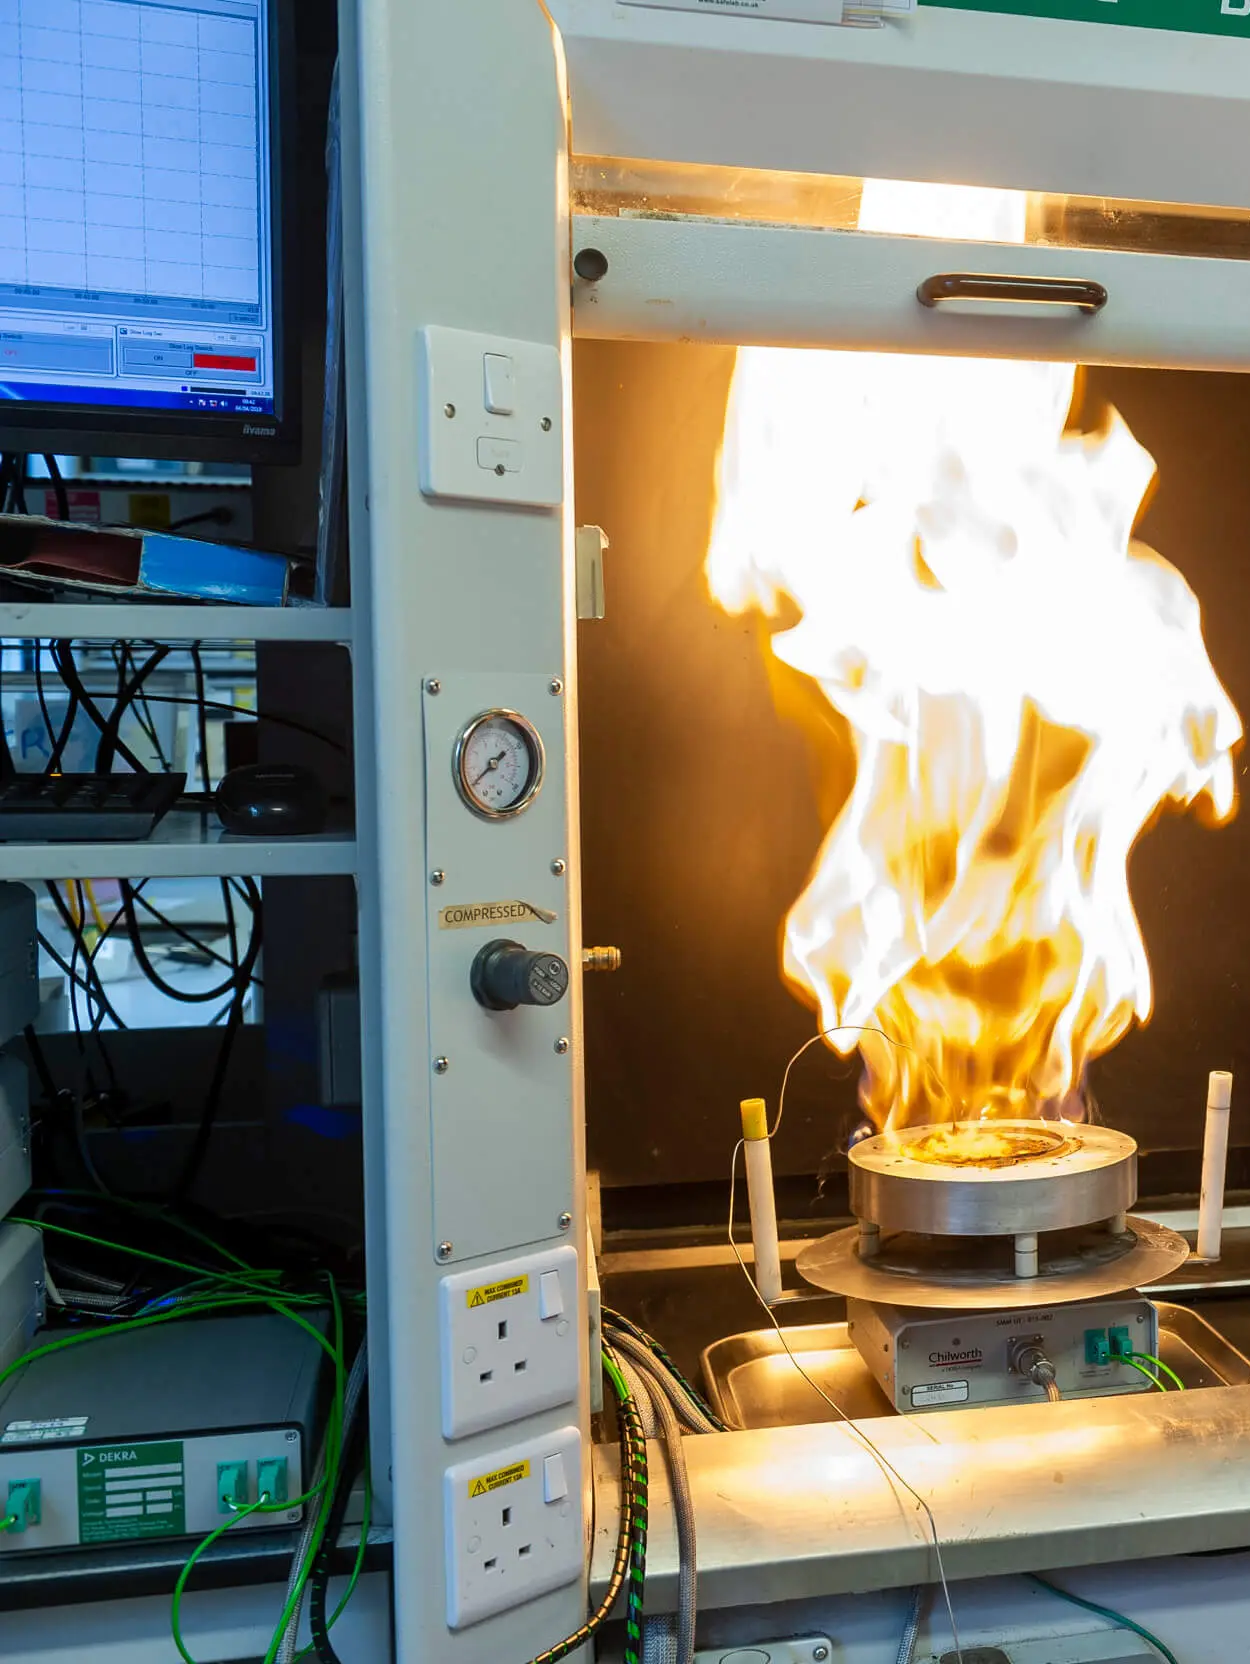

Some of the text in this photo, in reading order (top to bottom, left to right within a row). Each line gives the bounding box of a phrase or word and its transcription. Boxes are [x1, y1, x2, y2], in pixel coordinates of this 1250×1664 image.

[444, 904, 526, 923] COMPRESSED
[928, 1347, 983, 1363] Chilworth
[99, 1450, 138, 1463] DEKRA
